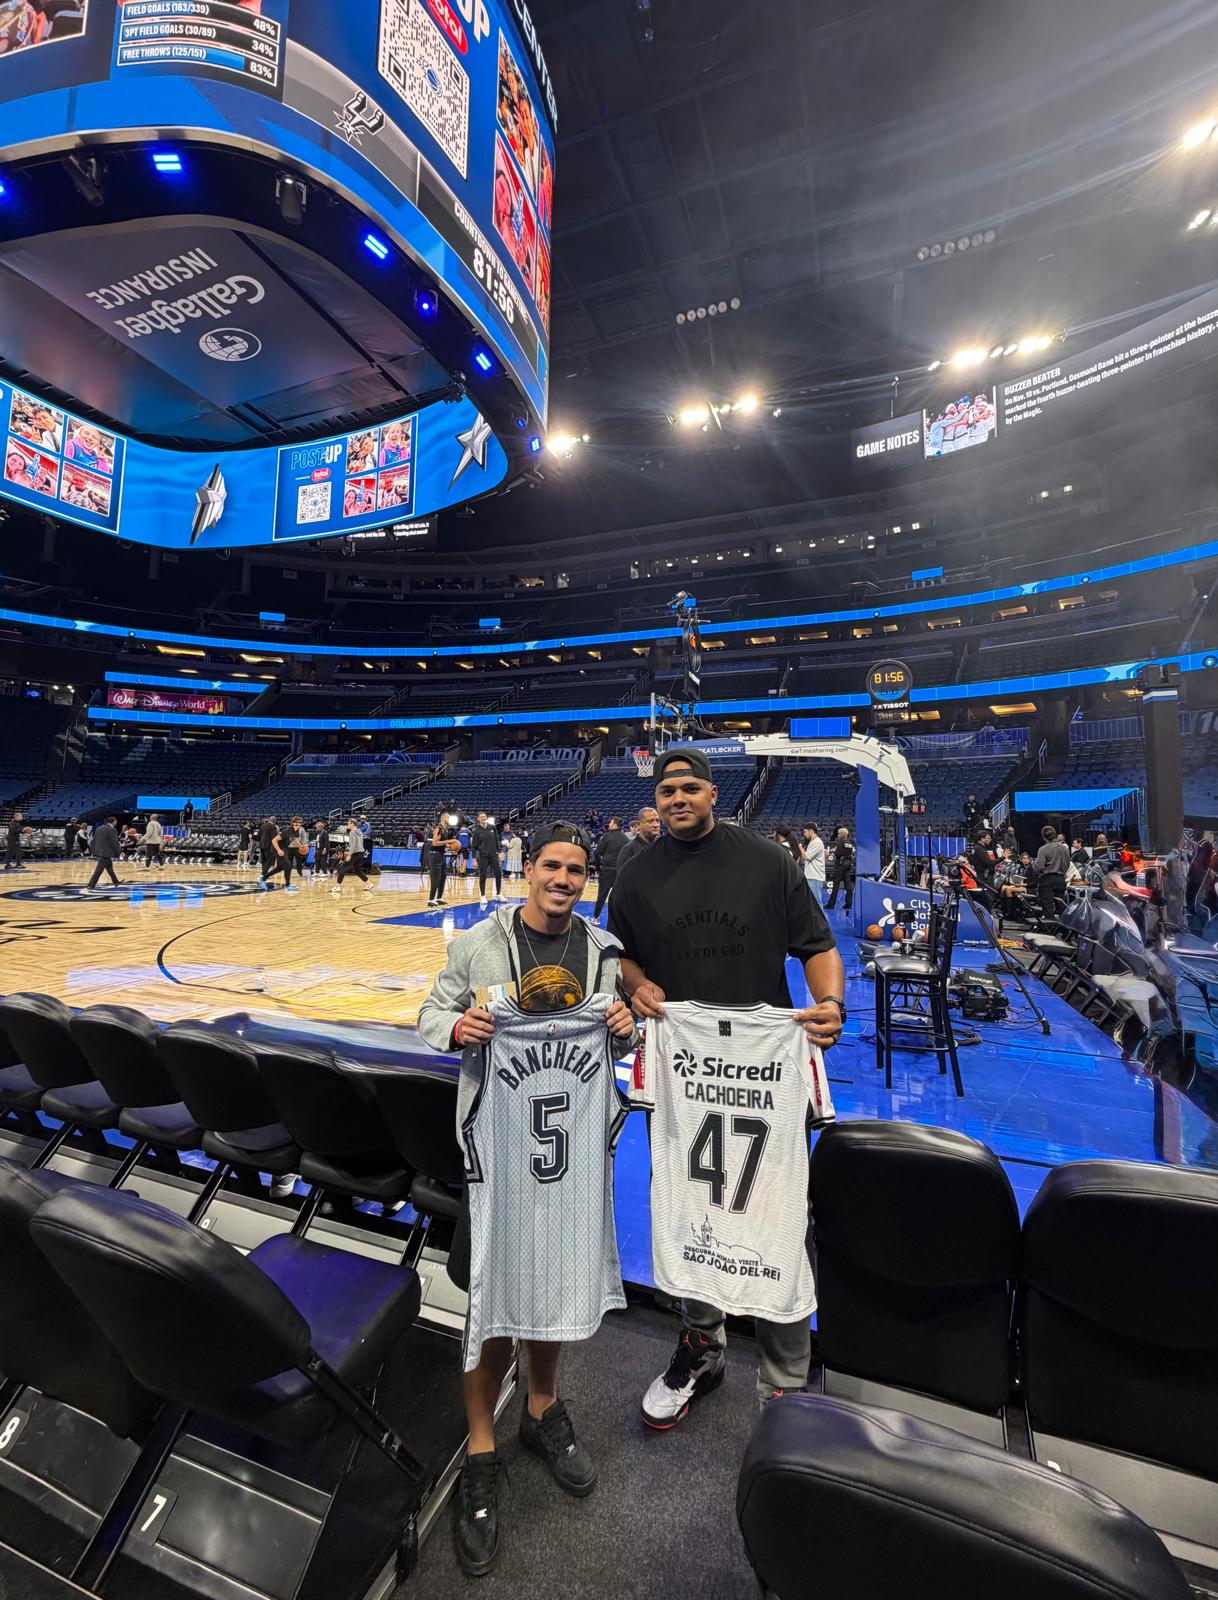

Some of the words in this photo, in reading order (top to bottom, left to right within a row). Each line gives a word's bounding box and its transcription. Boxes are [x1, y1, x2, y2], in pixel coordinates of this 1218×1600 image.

[127, 5, 147, 16] FIELD
[148, 3, 171, 14] GOALS
[172, 3, 210, 15] (163/339)
[253, 18, 275, 36] 48%
[431, 0, 463, 46] otal
[124, 26, 138, 38] 3PT
[139, 25, 159, 37] FIELD
[160, 24, 184, 36] GOALS
[185, 24, 216, 38] (30/89)
[251, 39, 274, 57] 34%
[123, 48, 140, 60] FREE
[141, 47, 171, 58] THROWS
[172, 47, 206, 59] (125/151)
[250, 61, 272, 79] 83%
[85, 247, 218, 310] INSURANCE
[473, 247, 515, 324] 81:56
[114, 274, 265, 338] Gallagher
[1005, 402, 1027, 416] marked
[1027, 399, 1037, 408] the
[1037, 391, 1056, 405] fourth
[1055, 373, 1101, 398] buzzer-beating
[1101, 355, 1145, 380] three-pointer
[1144, 351, 1153, 361] in
[1152, 336, 1187, 358] franchise
[1186, 323, 1216, 343] history,
[1013, 393, 1026, 404] Nov.
[1033, 388, 1042, 396] vs.
[1041, 376, 1069, 393] Portland,
[1068, 363, 1098, 382] Desmond
[1097, 358, 1115, 371] Bane
[1114, 352, 1125, 364] hit
[1129, 330, 1176, 357] three-pointer
[1175, 325, 1184, 336] at
[1183, 319, 1197, 332] the
[1004, 378, 1032, 396] BUZZER
[1032, 367, 1061, 386] BEATER
[1005, 417, 1013, 425] by
[1013, 413, 1023, 422] the
[1023, 406, 1043, 419] Magic.
[856, 439, 886, 458] GAME
[886, 430, 920, 450] NOTES
[179, 699, 205, 709] World
[698, 745, 742, 754] EATLOCKER
[910, 899, 931, 911] City
[659, 908, 751, 943] SSENTIALS
[497, 1041, 601, 1091] BANCHERO
[702, 1057, 782, 1082] Sicredi
[685, 1081, 774, 1110] CACHOEIRA
[528, 1092, 570, 1184] 5
[688, 1111, 771, 1214] 47
[684, 1245, 715, 1256] DESCUBRA
[738, 1258, 759, 1266] VISITE
[0, 1416, 20, 1449] 8
[140, 1494, 168, 1532] 7
